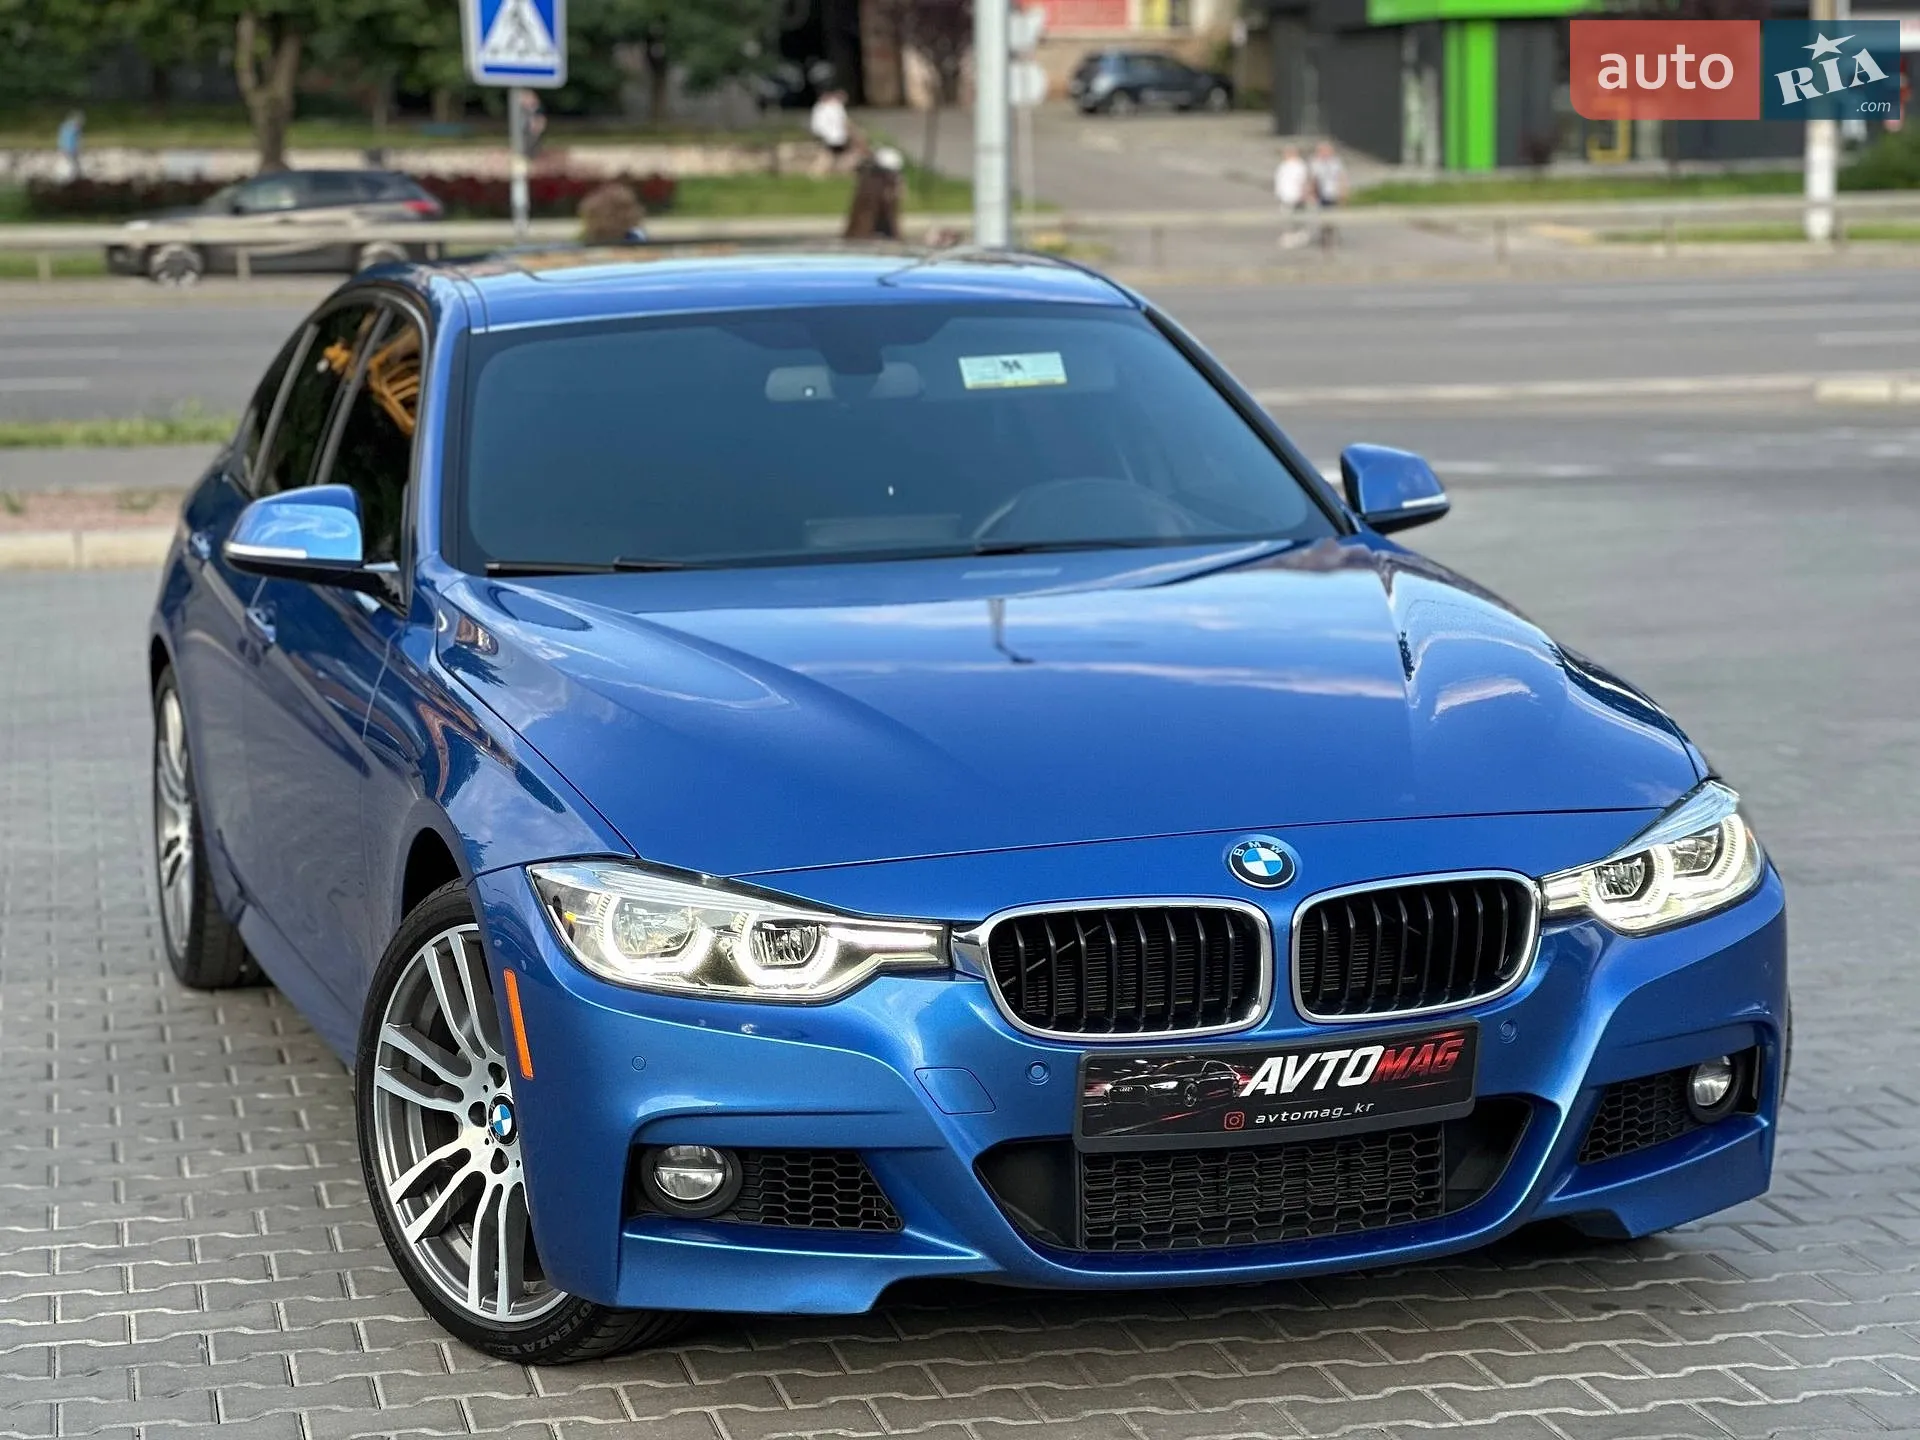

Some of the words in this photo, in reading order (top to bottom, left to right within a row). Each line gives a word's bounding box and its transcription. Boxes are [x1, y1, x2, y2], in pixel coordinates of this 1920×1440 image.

[1233, 841, 1283, 857] BMW
[1240, 1038, 1465, 1097] AVTOMAG
[1255, 1101, 1375, 1125] avtomag_kr
[522, 1301, 593, 1353] OTENZA
